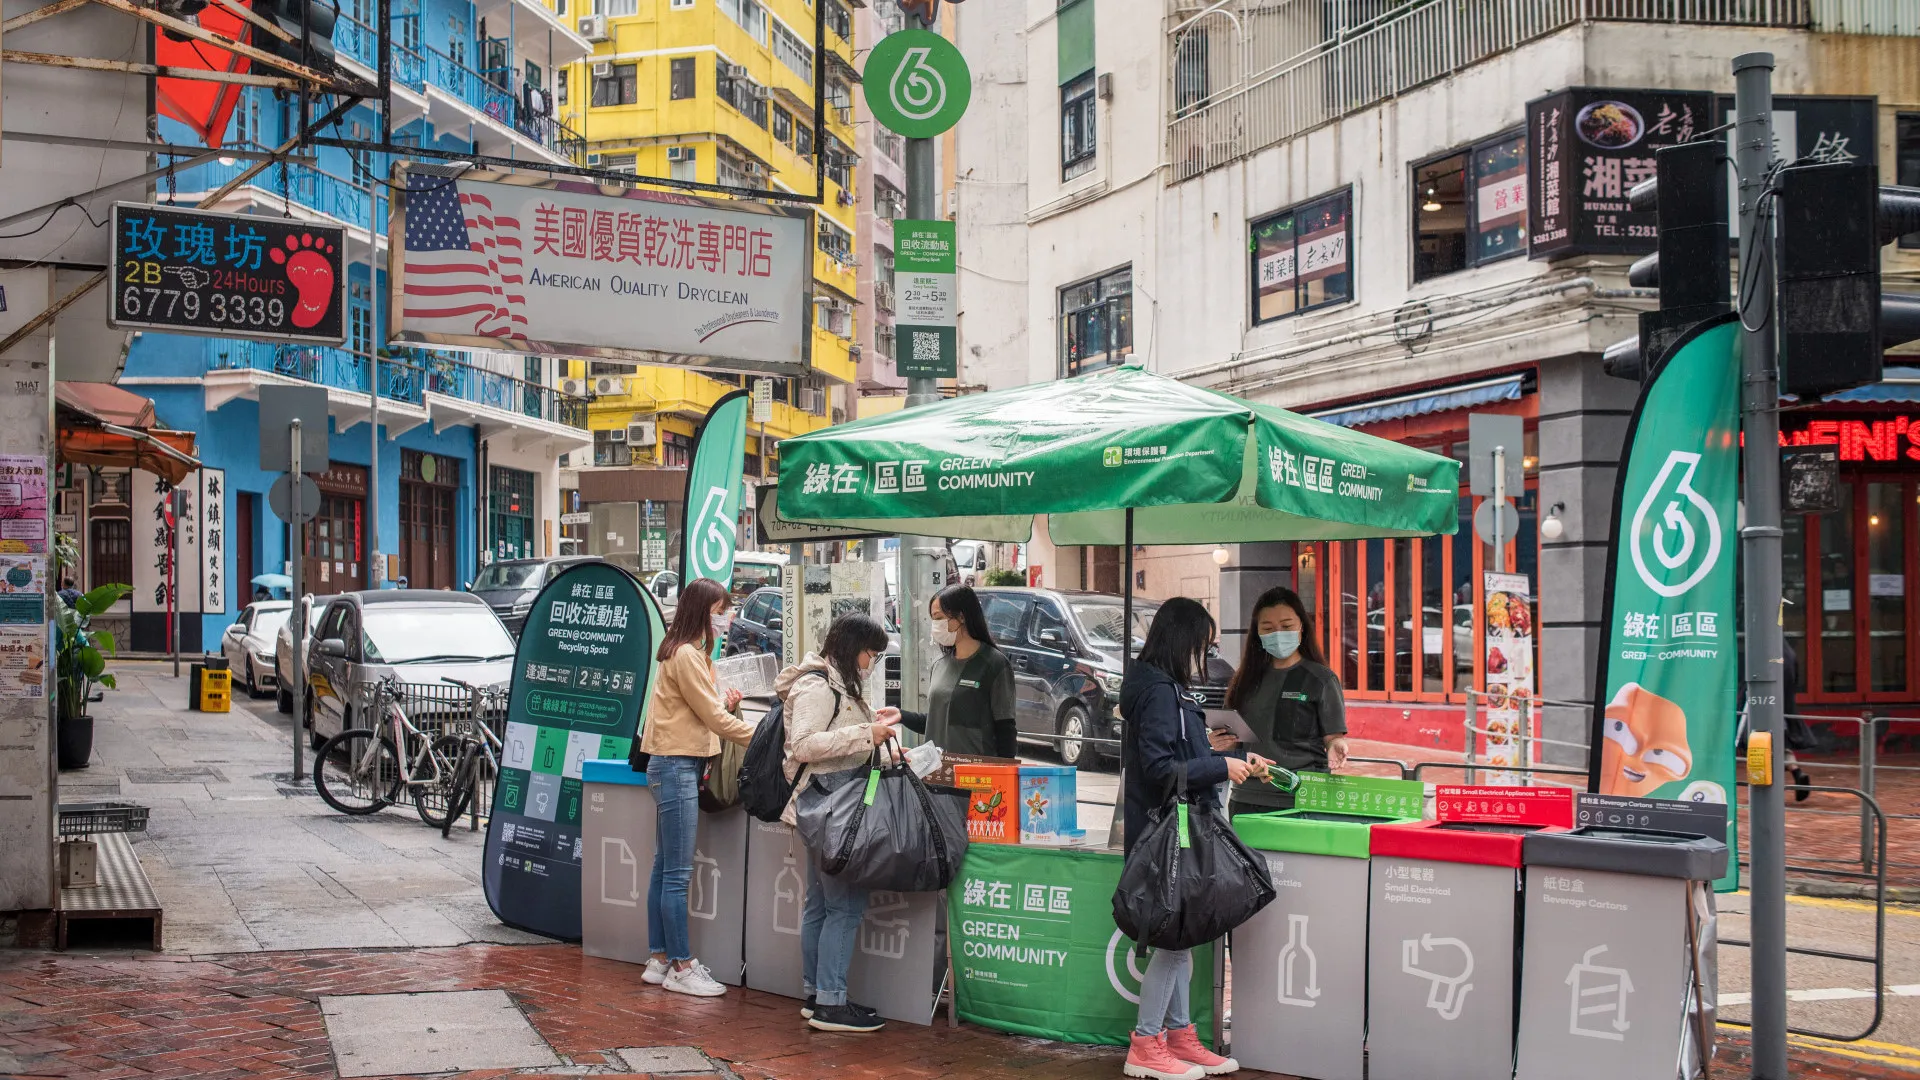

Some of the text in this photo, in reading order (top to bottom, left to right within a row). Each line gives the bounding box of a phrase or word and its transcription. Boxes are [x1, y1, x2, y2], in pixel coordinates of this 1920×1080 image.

[1584, 202, 1624, 211] HUNAN
[125, 217, 266, 270] 玫瑰坊
[532, 202, 773, 278] 美國優質乾洗專門店
[901, 239, 949, 251] 回收流動點
[125, 260, 162, 284] 2B
[213, 270, 285, 295] 24Hours
[610, 275, 669, 298] QUALITY
[678, 281, 749, 306] DRYCLEAN
[905, 290, 912, 301] 2
[931, 290, 939, 302] 5
[123, 286, 284, 326] 6779 3339
[1123, 457, 1161, 465] Environmental
[1184, 449, 1215, 457] Department
[802, 460, 929, 494] 綠在 區區
[1268, 445, 1336, 494] 綠在 區區
[938, 471, 1035, 490] COMMUNITY
[1338, 481, 1383, 501] COMMUNITY
[207, 476, 221, 606] 林鎮顯健身院
[571, 583, 615, 600] 綠在 區區
[785, 569, 794, 639] COASTLINE
[549, 601, 630, 629] 回收流動點
[1622, 612, 1718, 640] 綠在 區區
[548, 628, 625, 644] GREEN@COMMUNITY
[558, 641, 609, 655] Recycling Spots
[1658, 650, 1718, 661] COMMUNITY
[579, 670, 588, 686] 2
[611, 672, 621, 690] 5
[1461, 788, 1479, 796] Small
[1478, 789, 1504, 797] Electrical
[1504, 790, 1535, 798] Appliances
[590, 804, 604, 813] Paper
[1599, 799, 1628, 808] Beverage
[1628, 800, 1653, 809] Cartons
[1272, 877, 1302, 888] Bottles
[1385, 865, 1434, 882] 小型電器
[1384, 883, 1451, 896] Small Electrical
[1543, 875, 1585, 894] 紙包盒
[963, 877, 1073, 915] 綠在 區區
[1384, 892, 1432, 905] Appliances
[1542, 893, 1628, 911] Beverage Cartons
[962, 919, 1020, 941] GREEN
[963, 940, 1068, 968] COMMUNITY
